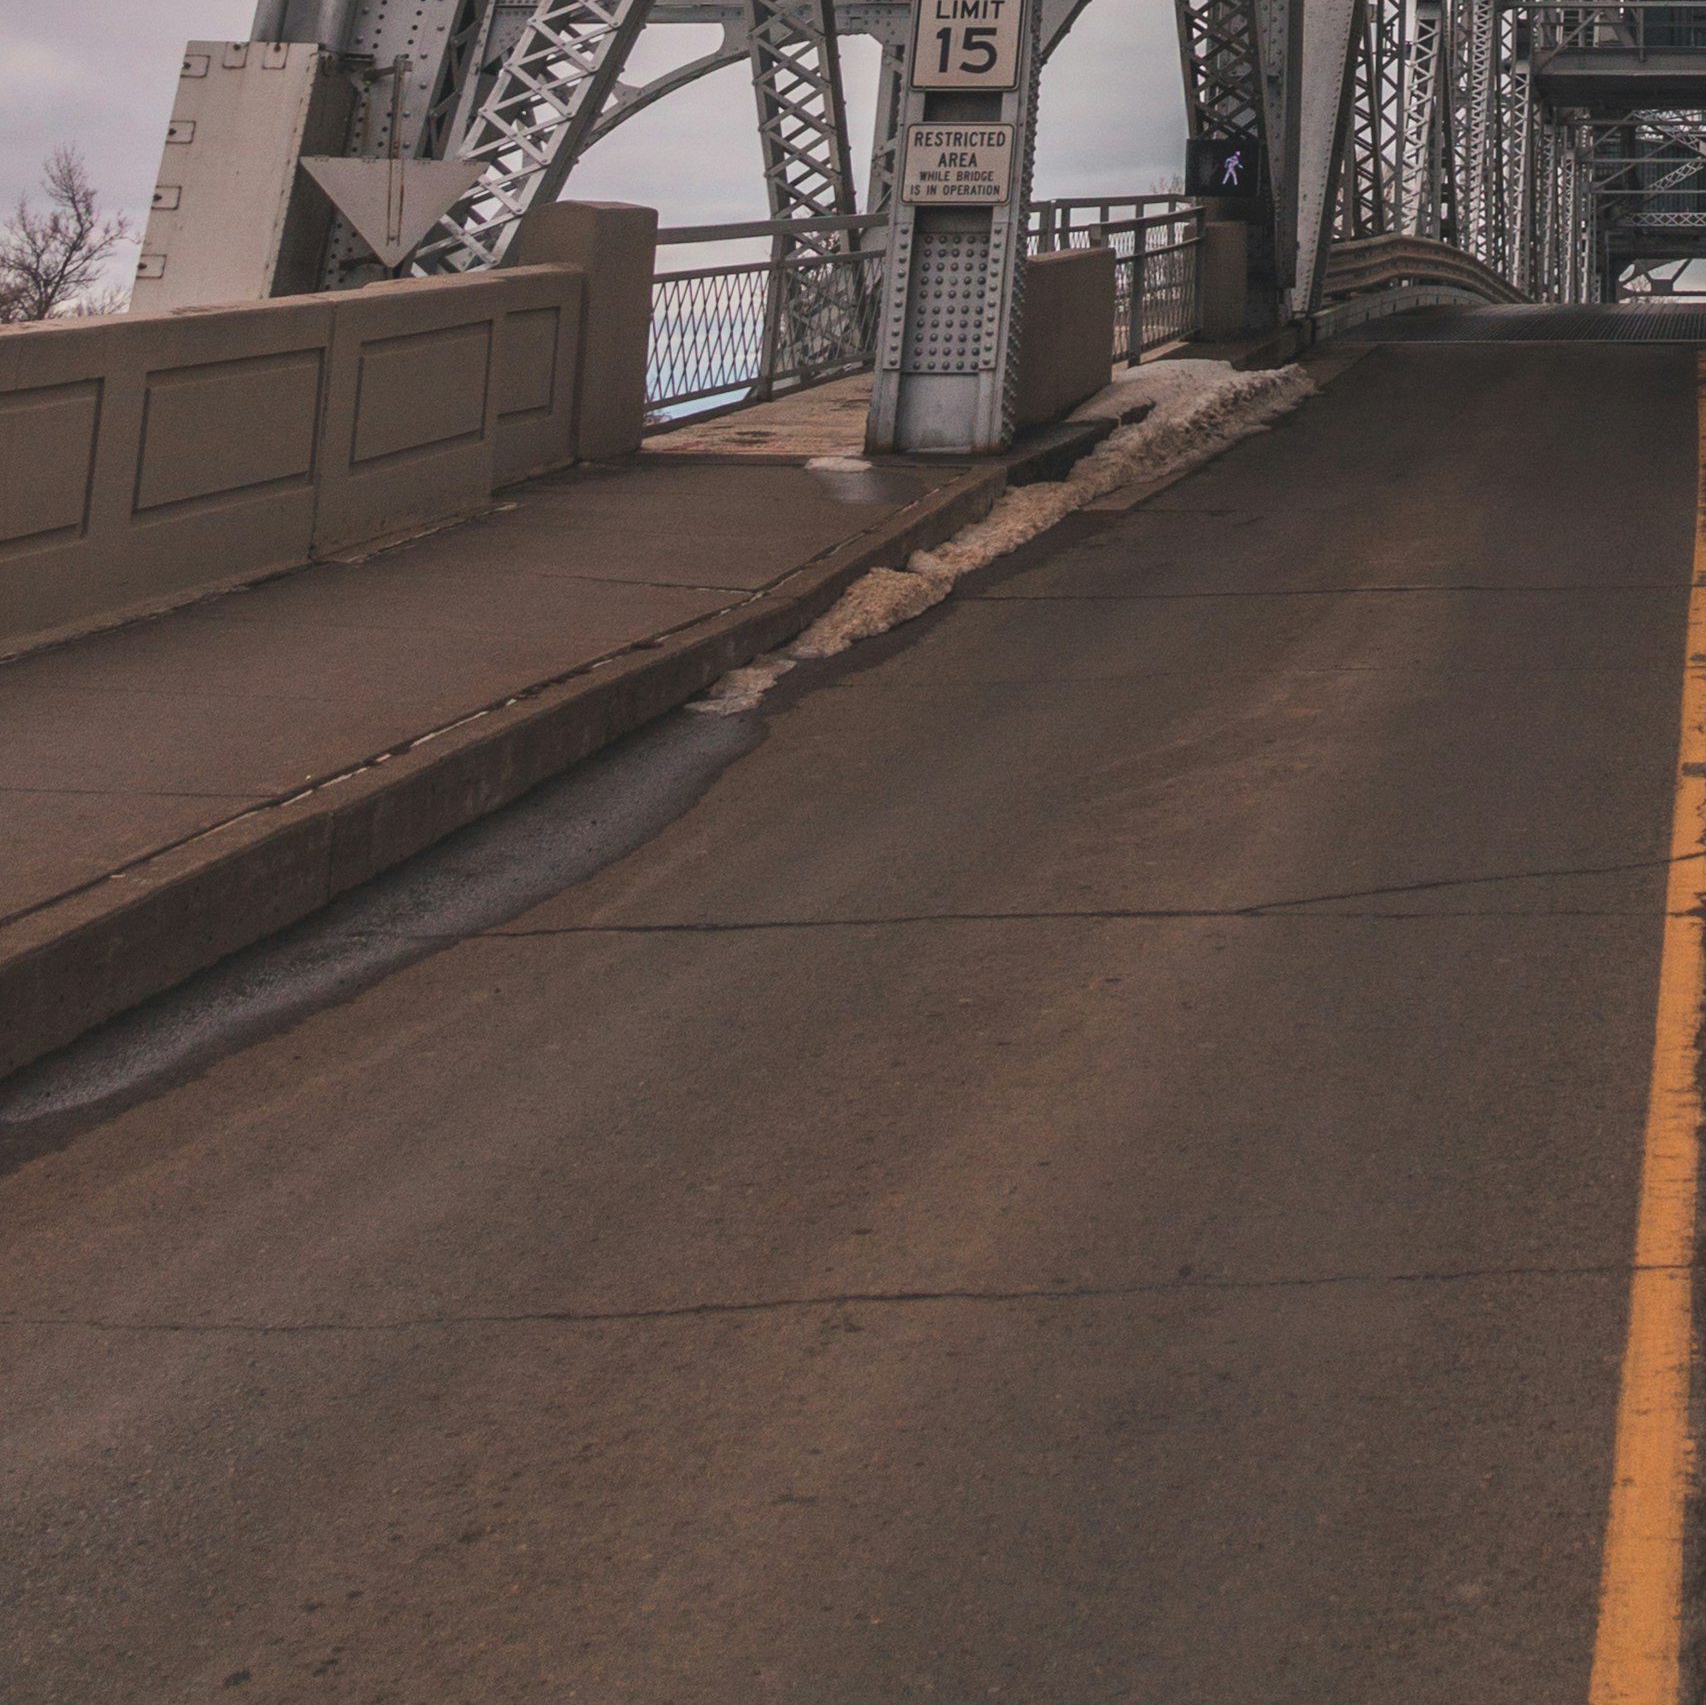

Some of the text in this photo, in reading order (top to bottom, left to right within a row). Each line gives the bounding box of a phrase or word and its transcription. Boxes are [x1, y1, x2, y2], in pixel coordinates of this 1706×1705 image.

[936, 0, 1005, 19] LIMIT
[936, 27, 998, 74] 15
[914, 131, 1006, 147] RESTRICTED
[938, 152, 977, 168] AREA
[919, 171, 994, 182] WHILE BRIDGE
[910, 185, 1000, 195] IS IN OPERATION
